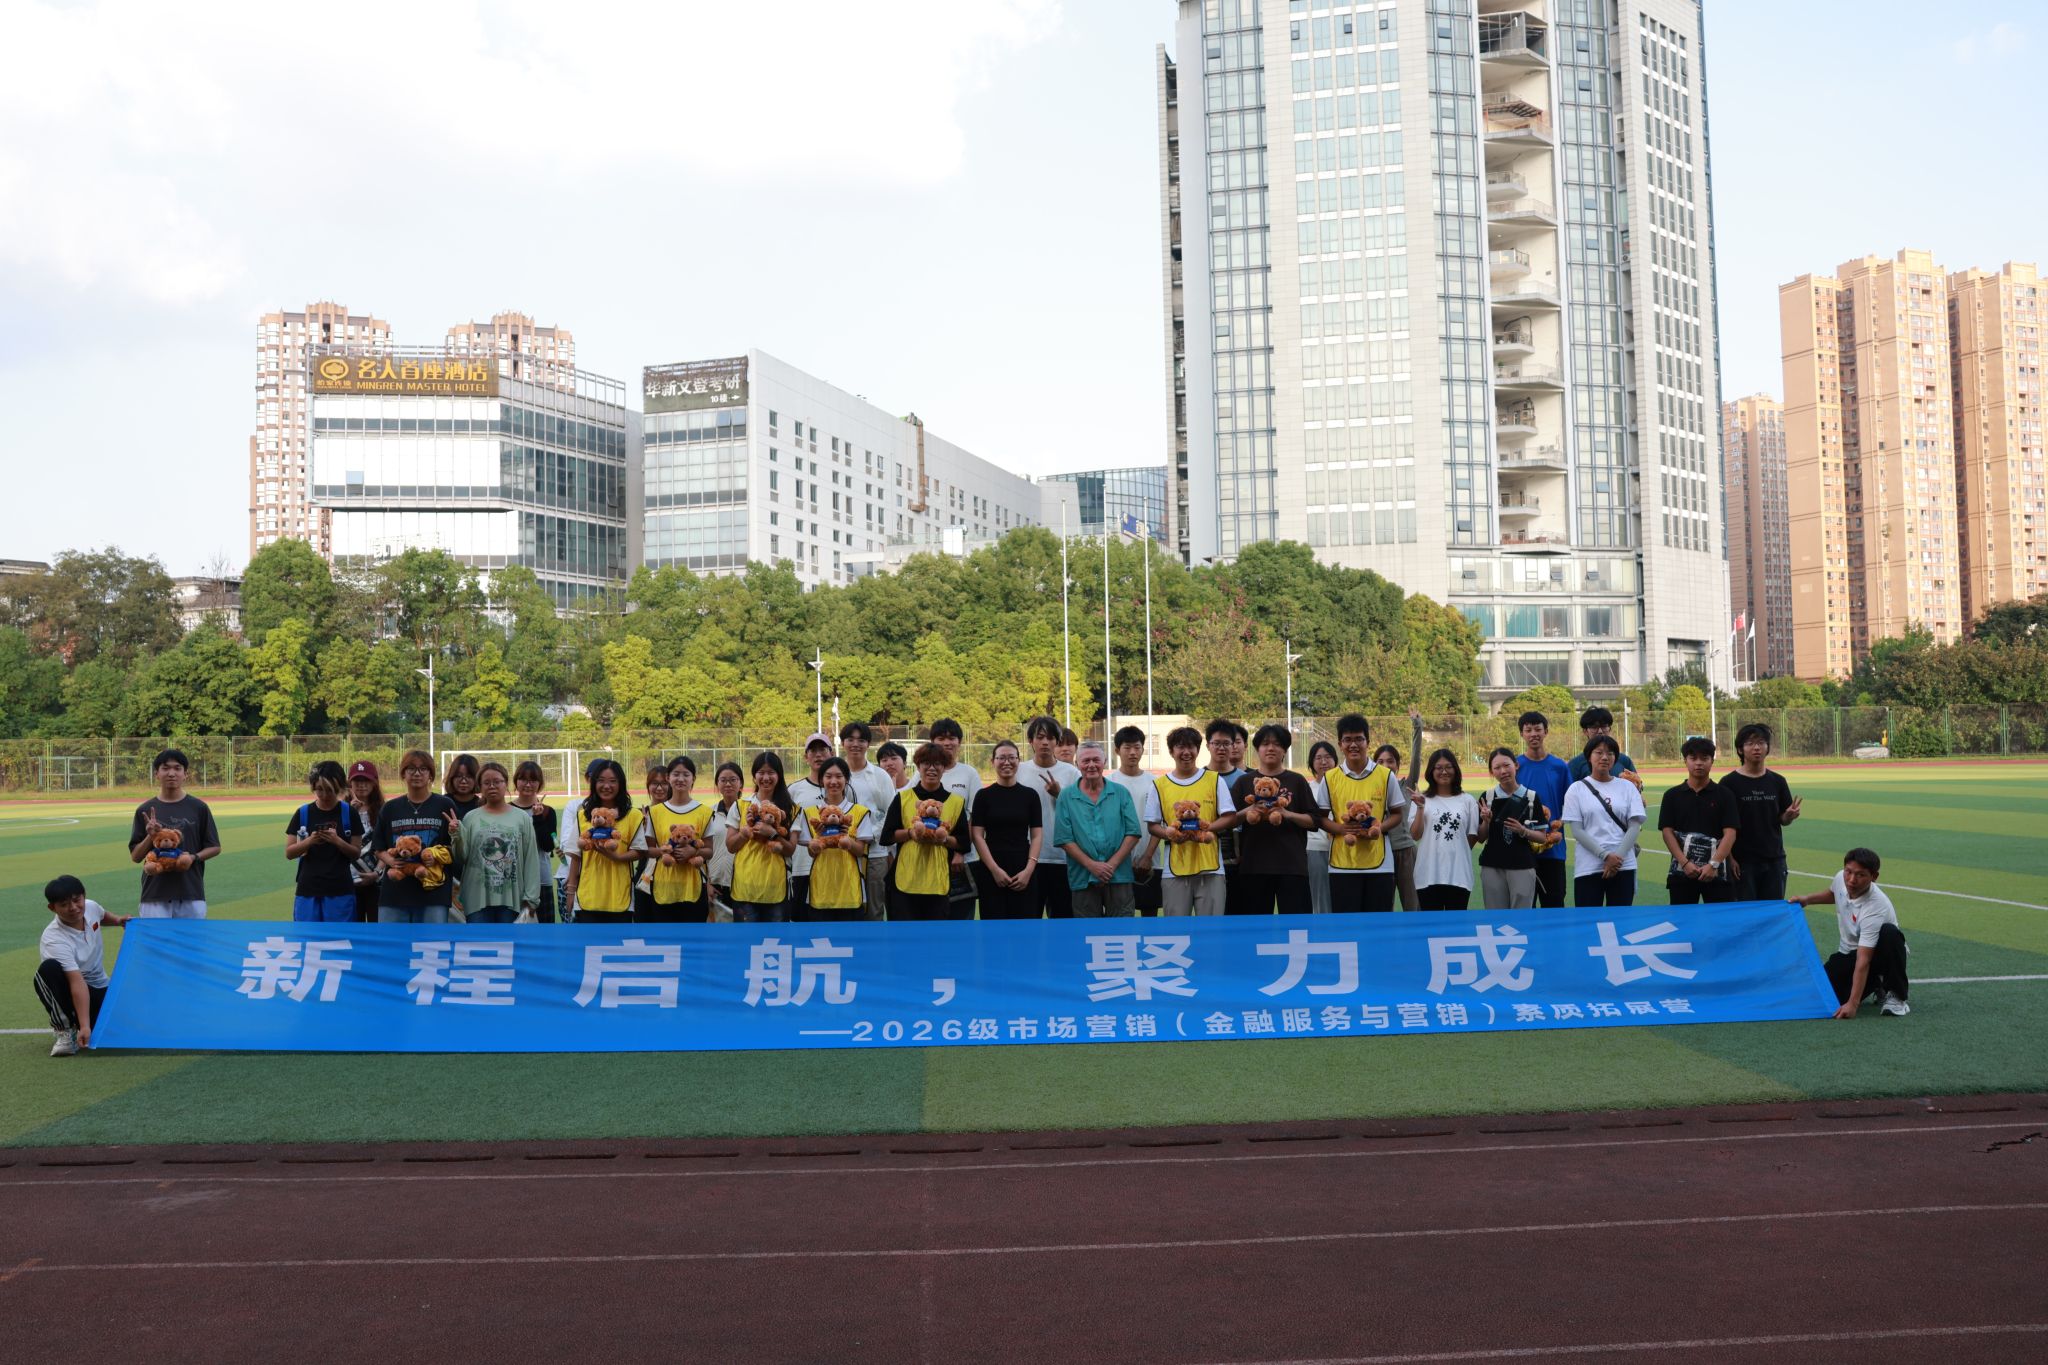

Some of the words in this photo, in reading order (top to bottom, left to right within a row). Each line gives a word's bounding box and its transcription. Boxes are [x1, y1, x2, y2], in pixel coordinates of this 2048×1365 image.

[357, 358, 488, 381] 名人首座酒店
[356, 381, 403, 390] MINGREN
[407, 382, 451, 391] MASTER
[455, 384, 488, 392] HOTEL
[391, 818, 415, 828] MICHAEL
[415, 817, 442, 827] JACKSON
